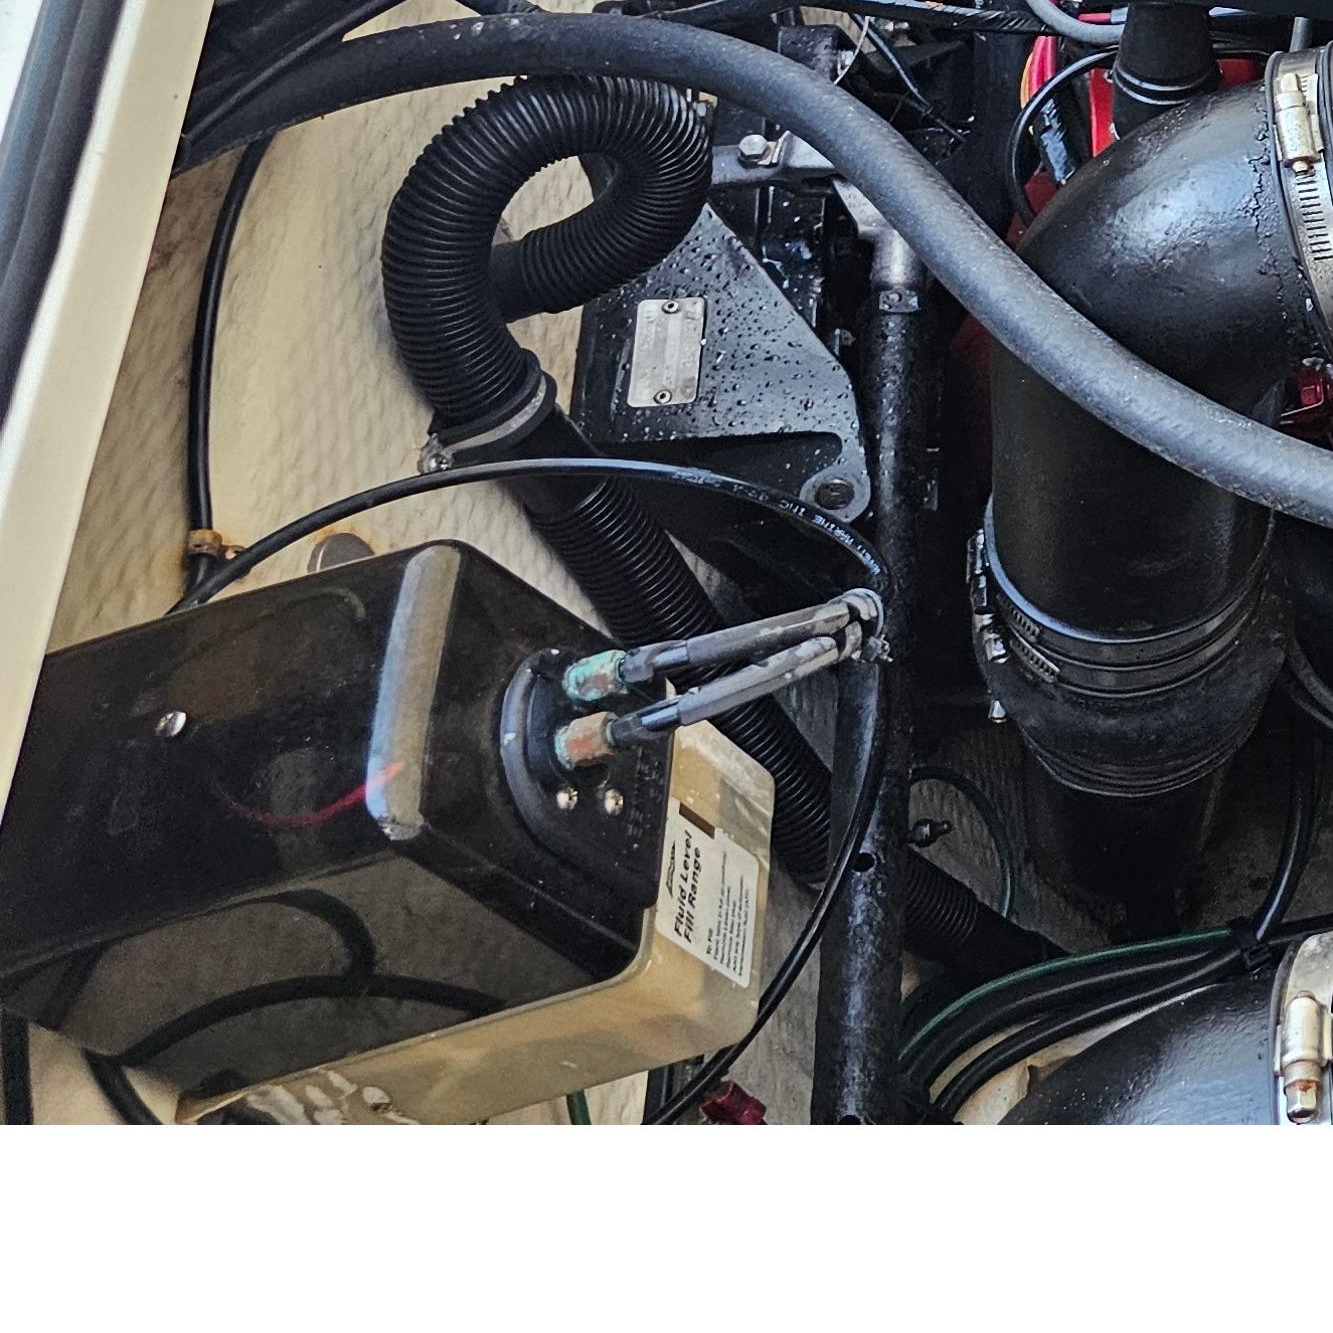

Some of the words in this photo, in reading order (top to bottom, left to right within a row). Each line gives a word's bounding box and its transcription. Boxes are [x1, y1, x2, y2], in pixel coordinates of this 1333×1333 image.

[811, 514, 854, 546] MARINE
[679, 828, 692, 884] Level
[687, 845, 702, 909] Range
[673, 883, 686, 936] Fluid
[683, 909, 694, 943] Fill
